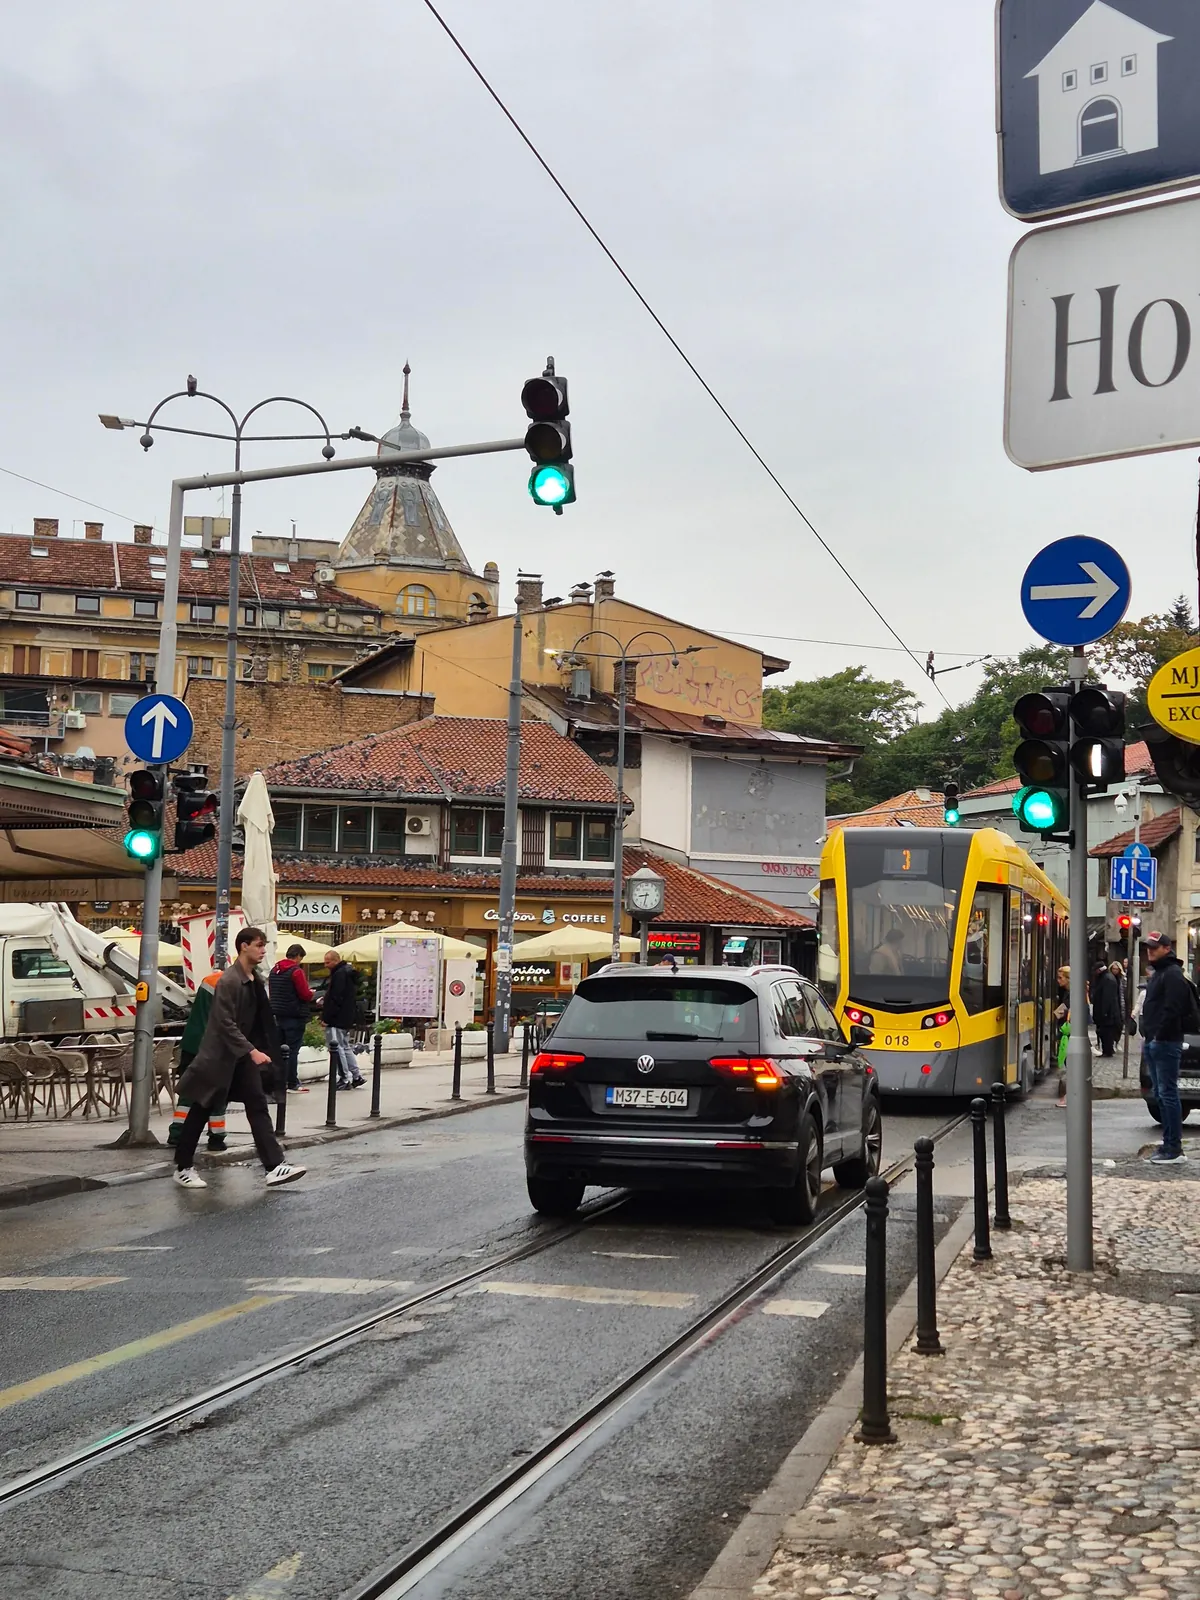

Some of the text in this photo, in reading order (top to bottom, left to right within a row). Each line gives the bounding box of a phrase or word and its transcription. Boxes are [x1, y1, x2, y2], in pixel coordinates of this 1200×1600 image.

[1049, 284, 1200, 402] HO
[286, 896, 340, 917] BAŠČA
[483, 909, 607, 923] Cabou COFFEE
[885, 1035, 909, 1046] 018
[615, 1089, 685, 1104] M37-E-604
